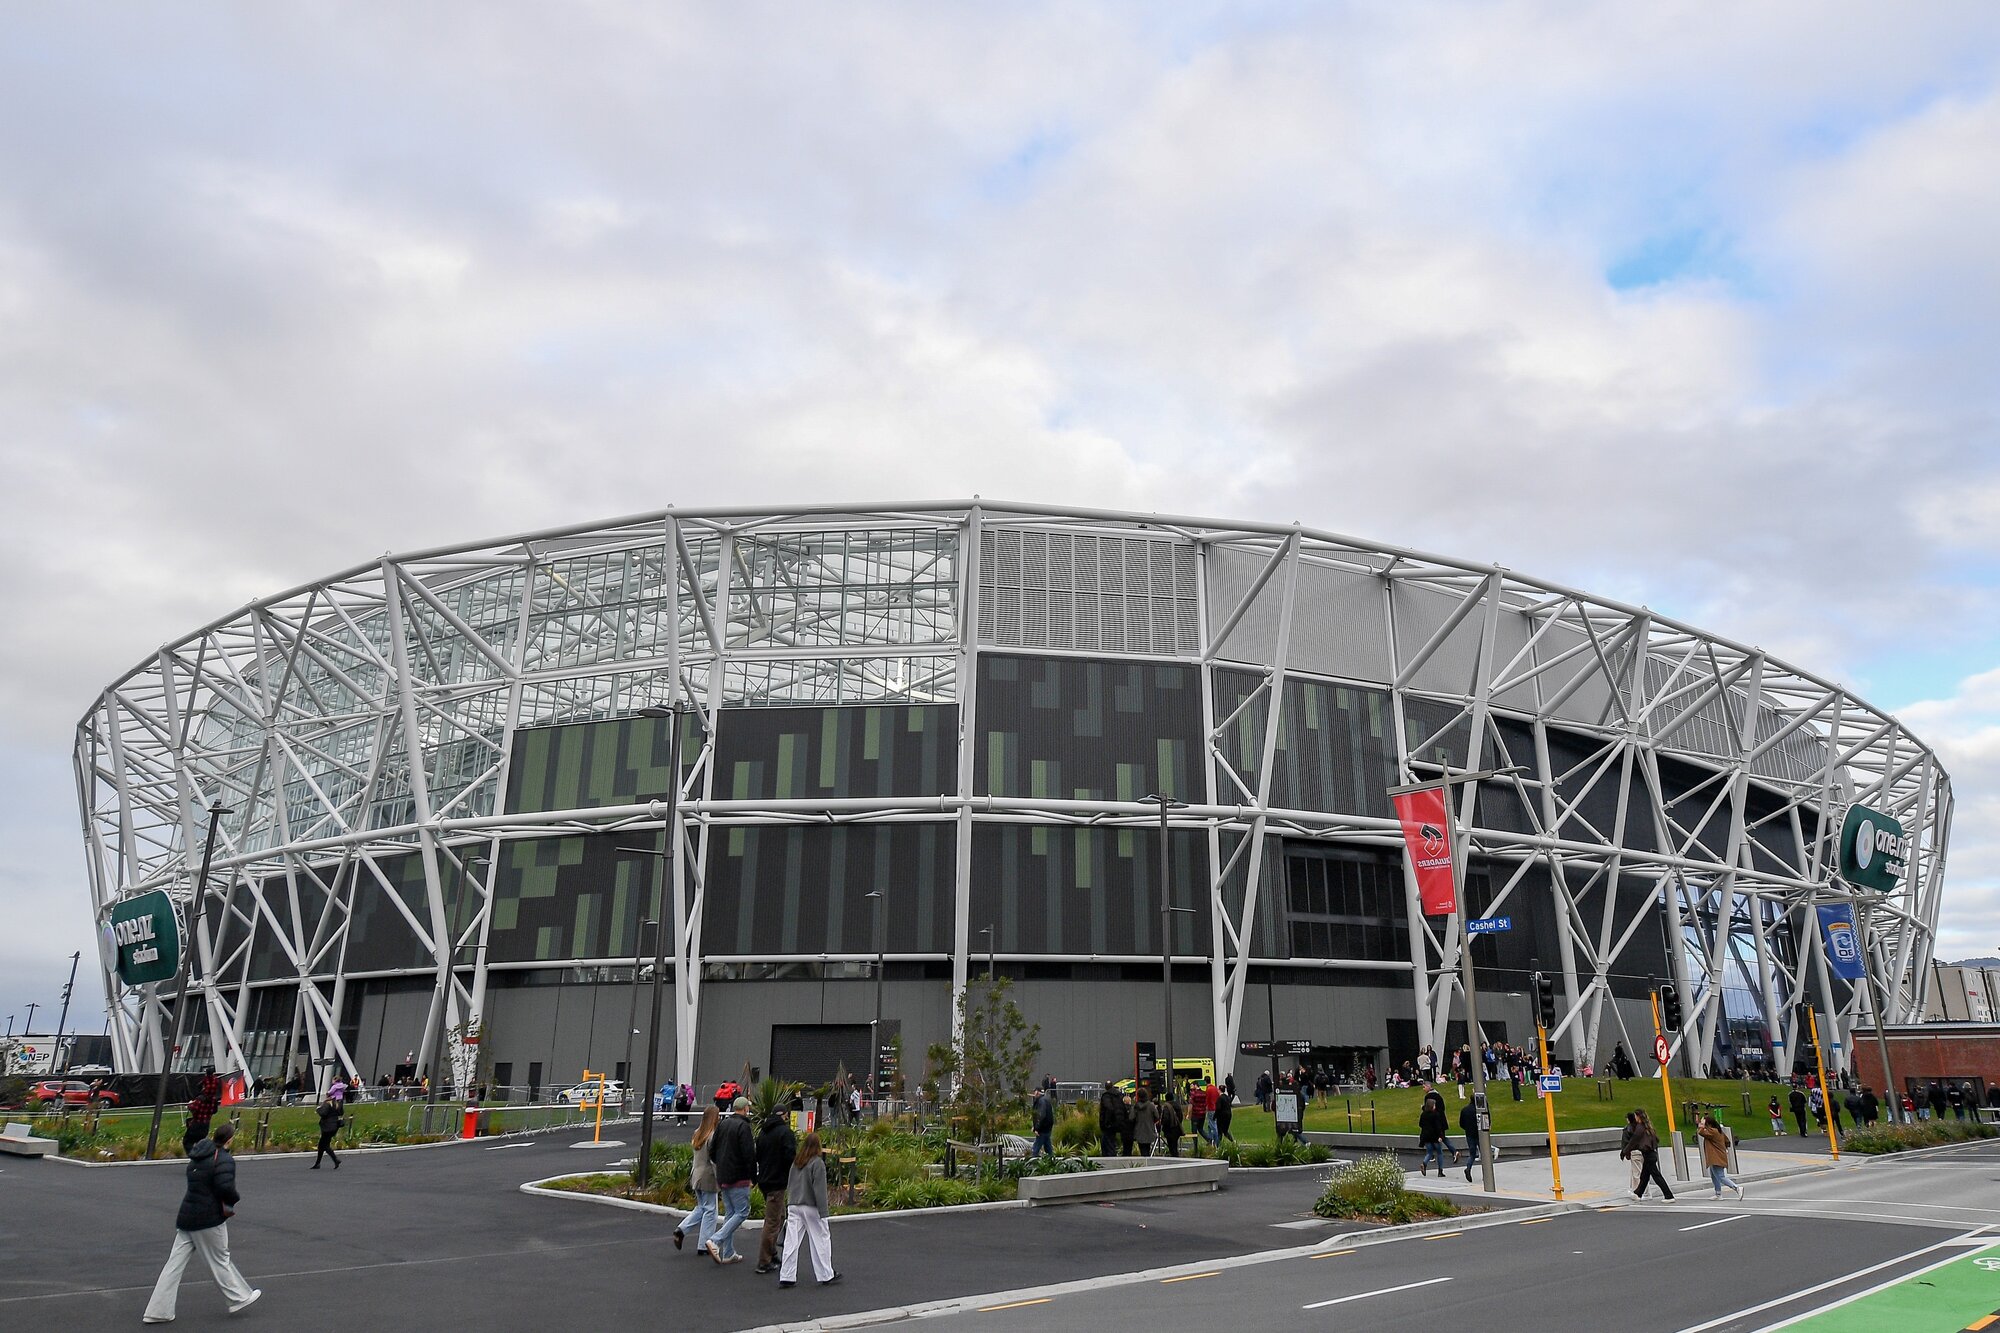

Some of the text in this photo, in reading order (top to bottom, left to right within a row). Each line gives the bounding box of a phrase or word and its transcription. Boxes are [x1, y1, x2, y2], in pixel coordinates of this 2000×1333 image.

[115, 913, 156, 947] one.nz
[1469, 919, 1508, 931] Cashel St
[132, 943, 159, 965] stadium
[28, 1053, 50, 1062] NEP
